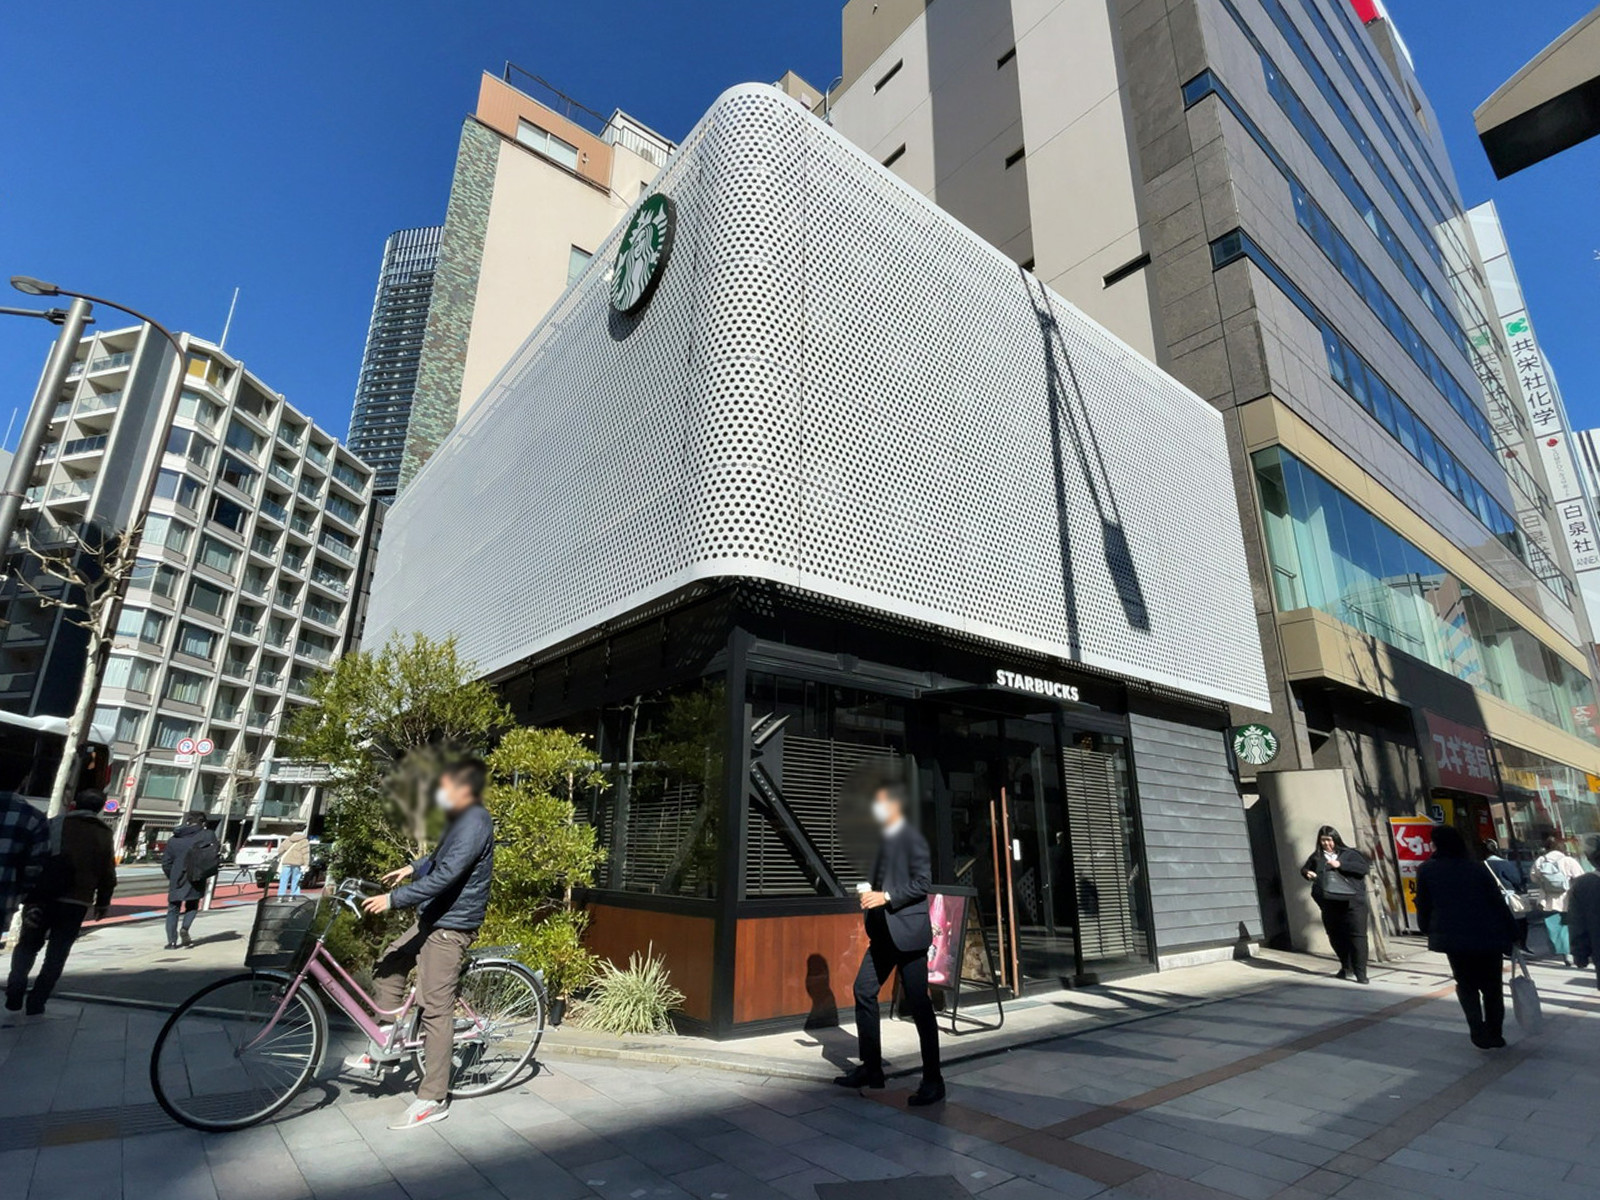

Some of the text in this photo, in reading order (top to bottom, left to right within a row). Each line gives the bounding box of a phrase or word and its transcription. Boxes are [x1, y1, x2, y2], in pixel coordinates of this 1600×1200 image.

[1512, 338, 1556, 426] 共栄社化学
[1564, 505, 1594, 553] 白泉社
[996, 669, 1079, 701] STARBUCKS
[1433, 733, 1492, 781] スギ薬局
